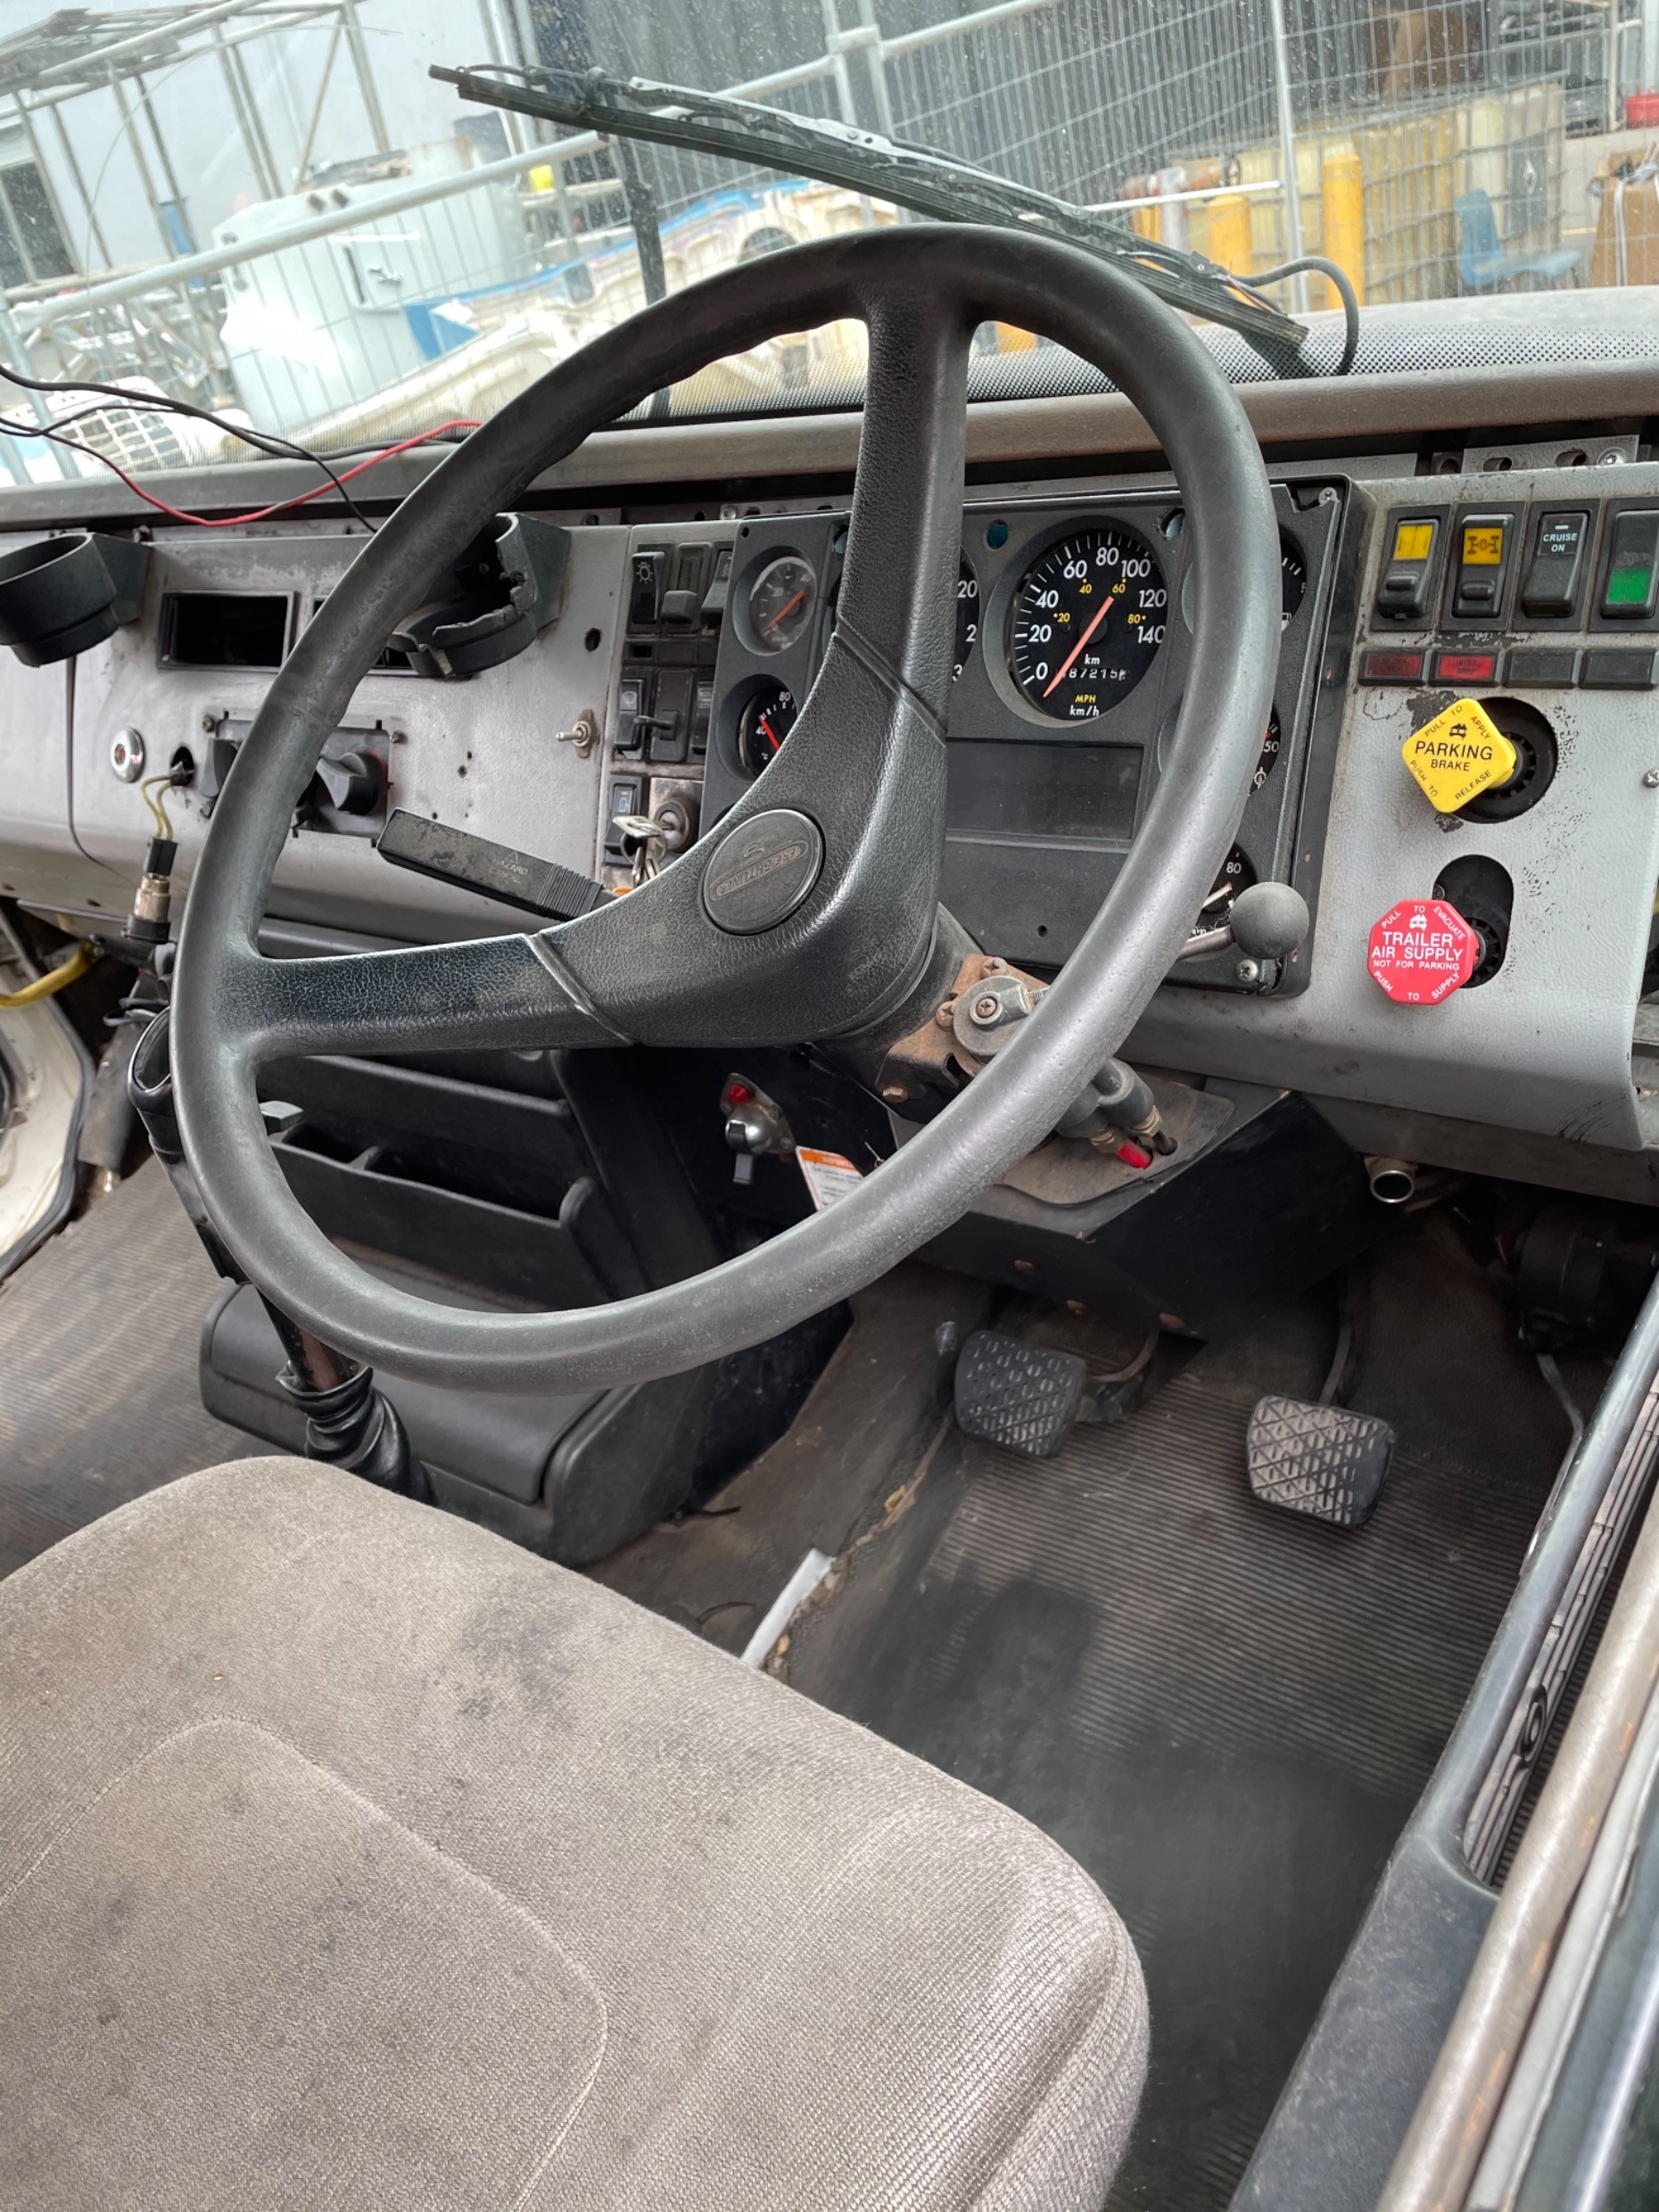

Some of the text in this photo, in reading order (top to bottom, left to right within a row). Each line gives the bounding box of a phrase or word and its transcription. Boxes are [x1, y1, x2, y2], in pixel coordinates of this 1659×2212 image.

[1543, 532, 1578, 542] CRUISE
[1551, 544, 1565, 552] ON
[1095, 547, 1119, 566] 80
[1063, 559, 1088, 579] 60
[1121, 558, 1151, 578] 100
[772, 587, 783, 597] 20
[1079, 583, 1093, 594] 40
[1111, 583, 1127, 594] 60
[1036, 590, 1060, 609] 40
[1138, 589, 1168, 608] 120
[1057, 612, 1070, 623] 20
[1127, 614, 1141, 624] 80
[1028, 623, 1052, 643] 20
[1137, 625, 1167, 644] 140
[1085, 654, 1101, 665] km
[1036, 662, 1049, 681] 0
[779, 691, 791, 702] 80
[1075, 694, 1096, 704] MPH
[1069, 705, 1100, 717] km/h
[1424, 705, 1492, 739] PULL TO APPLY
[1415, 740, 1493, 761] PARKING
[1431, 758, 1471, 772] BRAKE
[1410, 759, 1492, 800] PUSH TO RELEASE
[1226, 862, 1242, 874] 80
[1381, 905, 1465, 941] PULL TO EVACUATE
[1382, 931, 1453, 947] TRAILER
[1372, 945, 1463, 961] AIR SUPPLY
[1374, 960, 1460, 971] NOT FOR PARKING
[1374, 970, 1460, 1001] PUSH TO SUPPLY
